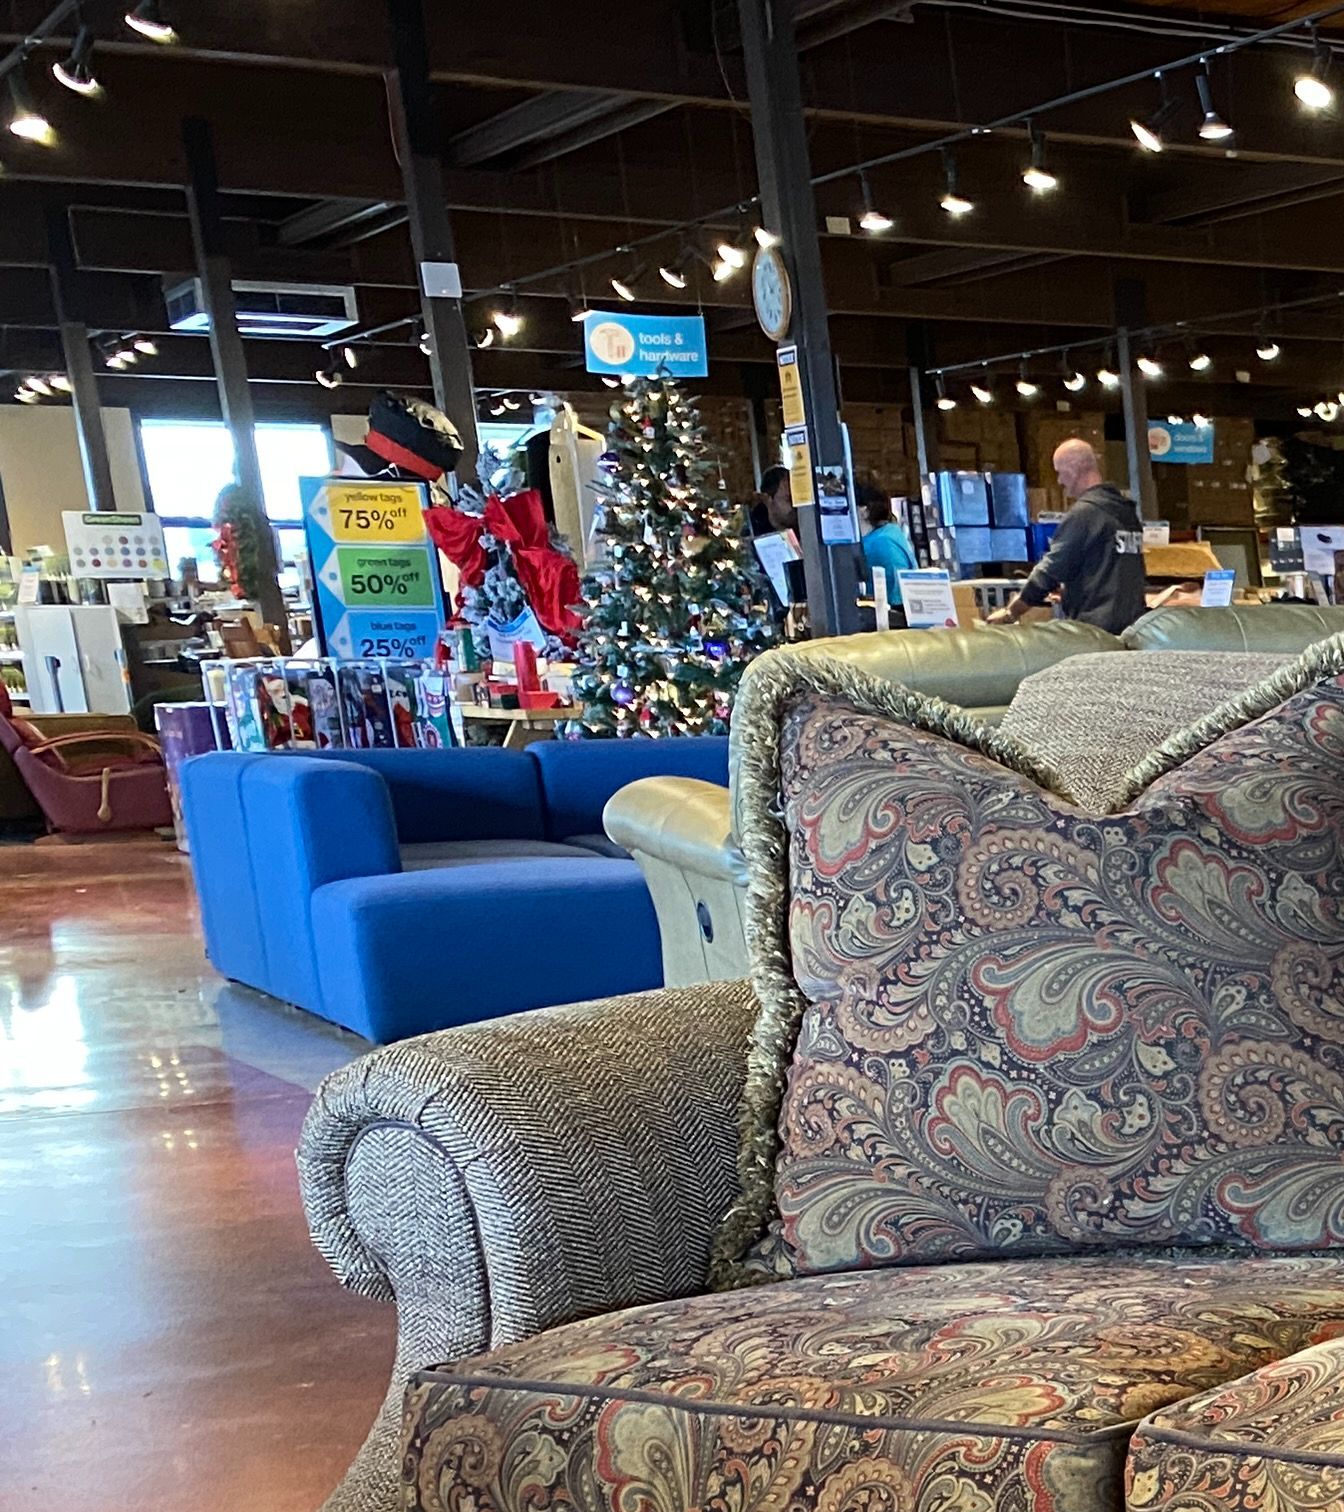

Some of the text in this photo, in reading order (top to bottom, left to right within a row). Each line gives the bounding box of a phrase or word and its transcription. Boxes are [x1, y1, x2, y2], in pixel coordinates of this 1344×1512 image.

[638, 332, 683, 346] tools &
[640, 349, 698, 362] hardware
[344, 492, 402, 504] yellow tags
[339, 507, 407, 530] 75% off
[351, 572, 419, 595] 50% off
[360, 635, 426, 658] 25% off
